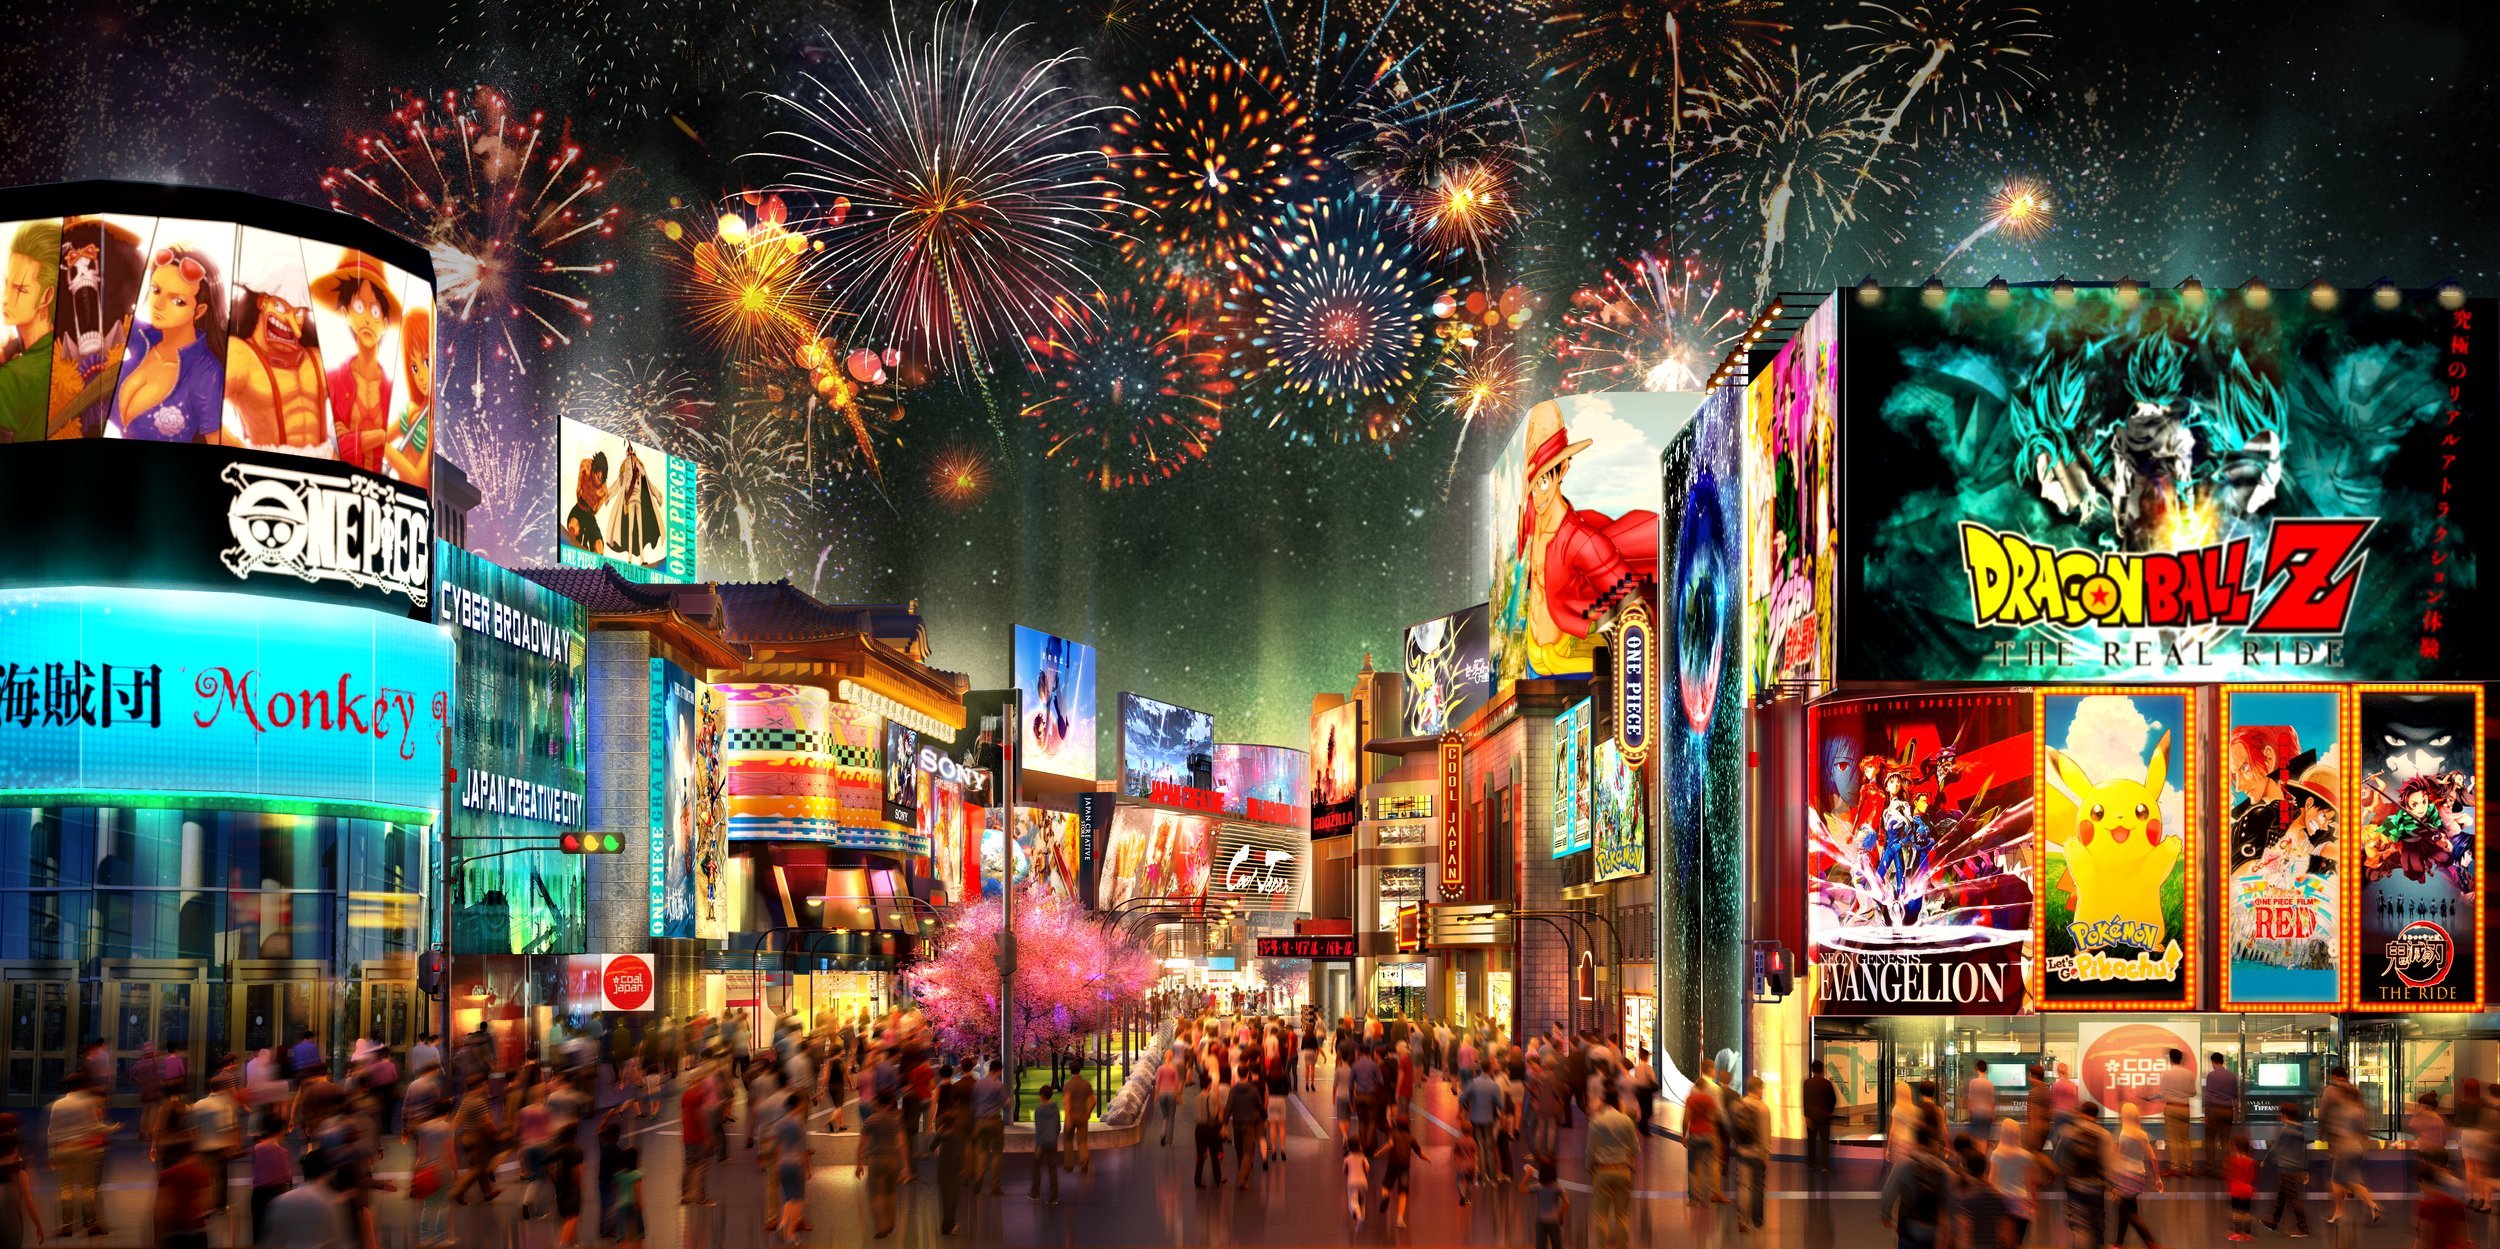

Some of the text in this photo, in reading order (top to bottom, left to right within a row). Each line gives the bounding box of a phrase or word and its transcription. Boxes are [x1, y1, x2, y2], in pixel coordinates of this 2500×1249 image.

[351, 474, 396, 504] ワンピース
[2420, 310, 2472, 660] 究極のリアルアトラクション体験
[670, 456, 686, 575] ONE PIECE
[685, 463, 696, 579] GRATE PIRATE
[362, 496, 428, 588] PIEC
[2243, 517, 2381, 635] Z
[441, 580, 571, 665] CYBER BROADWAY
[1995, 640, 2345, 667] THE REAL RIDE
[1625, 634, 1642, 737] ONE PIECE
[1919, 697, 2013, 708] APOCALYPSE
[193, 666, 416, 761] Monkey
[920, 746, 988, 791] SONY
[462, 768, 583, 827] JAPAN CREATIVE CITY
[651, 659, 664, 937] ONE PIECE GRATE PIRATE
[1149, 780, 1181, 808] JAPAN
[1448, 748, 1457, 879] COOL JAPAN
[894, 808, 909, 824] SONY
[1313, 811, 1353, 831] GODZILLA
[1226, 844, 1258, 893] Cool
[2255, 906, 2317, 941] RED
[620, 973, 643, 984] coal
[1819, 952, 1921, 965] NEON GENESIS
[2048, 957, 2074, 971] Let's
[2074, 939, 2184, 982] Pikachu!
[613, 984, 643, 994] japan
[1819, 962, 2008, 1003] EVANGELION
[2379, 986, 2457, 1000] THE RIDE
[2105, 1073, 2165, 1089] japa
